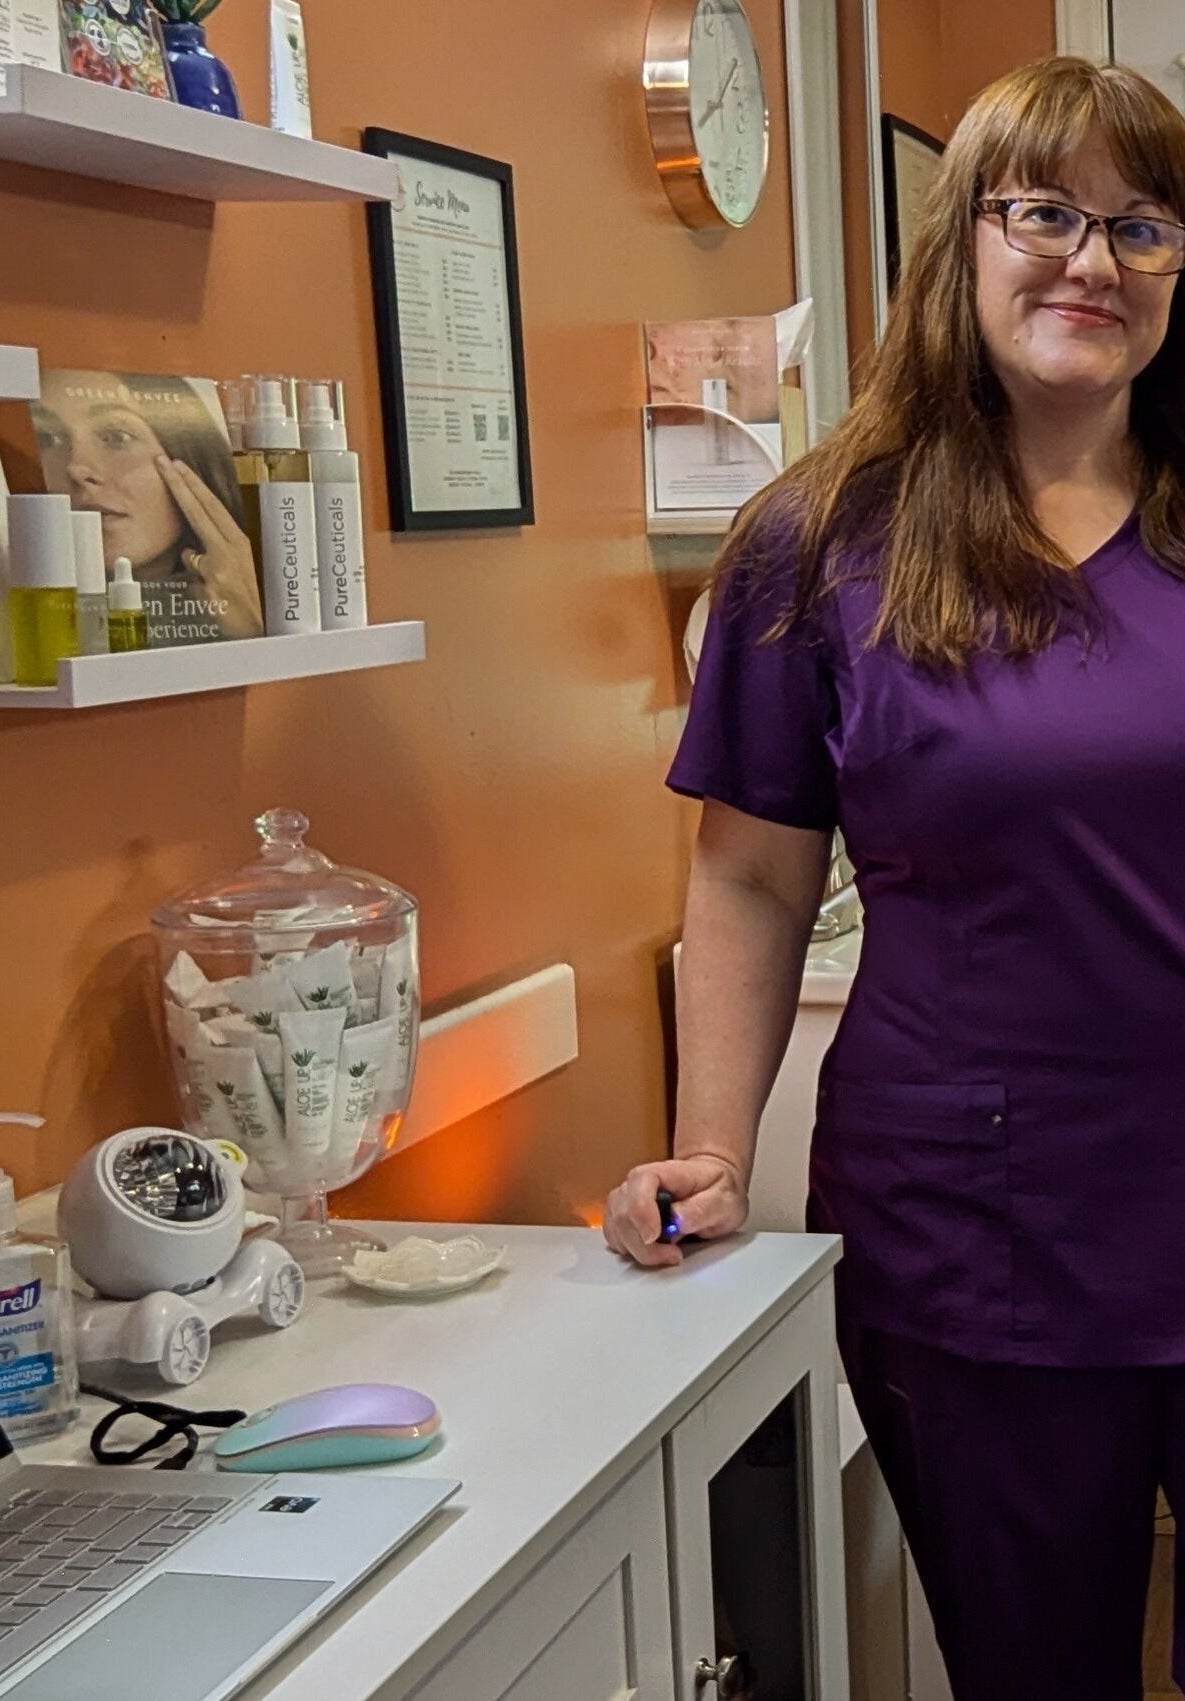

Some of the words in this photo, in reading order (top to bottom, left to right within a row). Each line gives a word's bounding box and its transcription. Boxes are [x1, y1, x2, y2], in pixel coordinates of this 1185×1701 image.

[414, 180, 445, 210] Service
[65, 386, 116, 399] GREEN
[134, 390, 180, 403] ENVEE
[280, 496, 299, 622] PureCeuticals
[329, 497, 349, 617] PureCeuticals
[171, 594, 228, 617] Envee
[297, 1067, 312, 1084] UP
[296, 1087, 312, 1117] ALOE
[0, 1287, 34, 1312] rell
